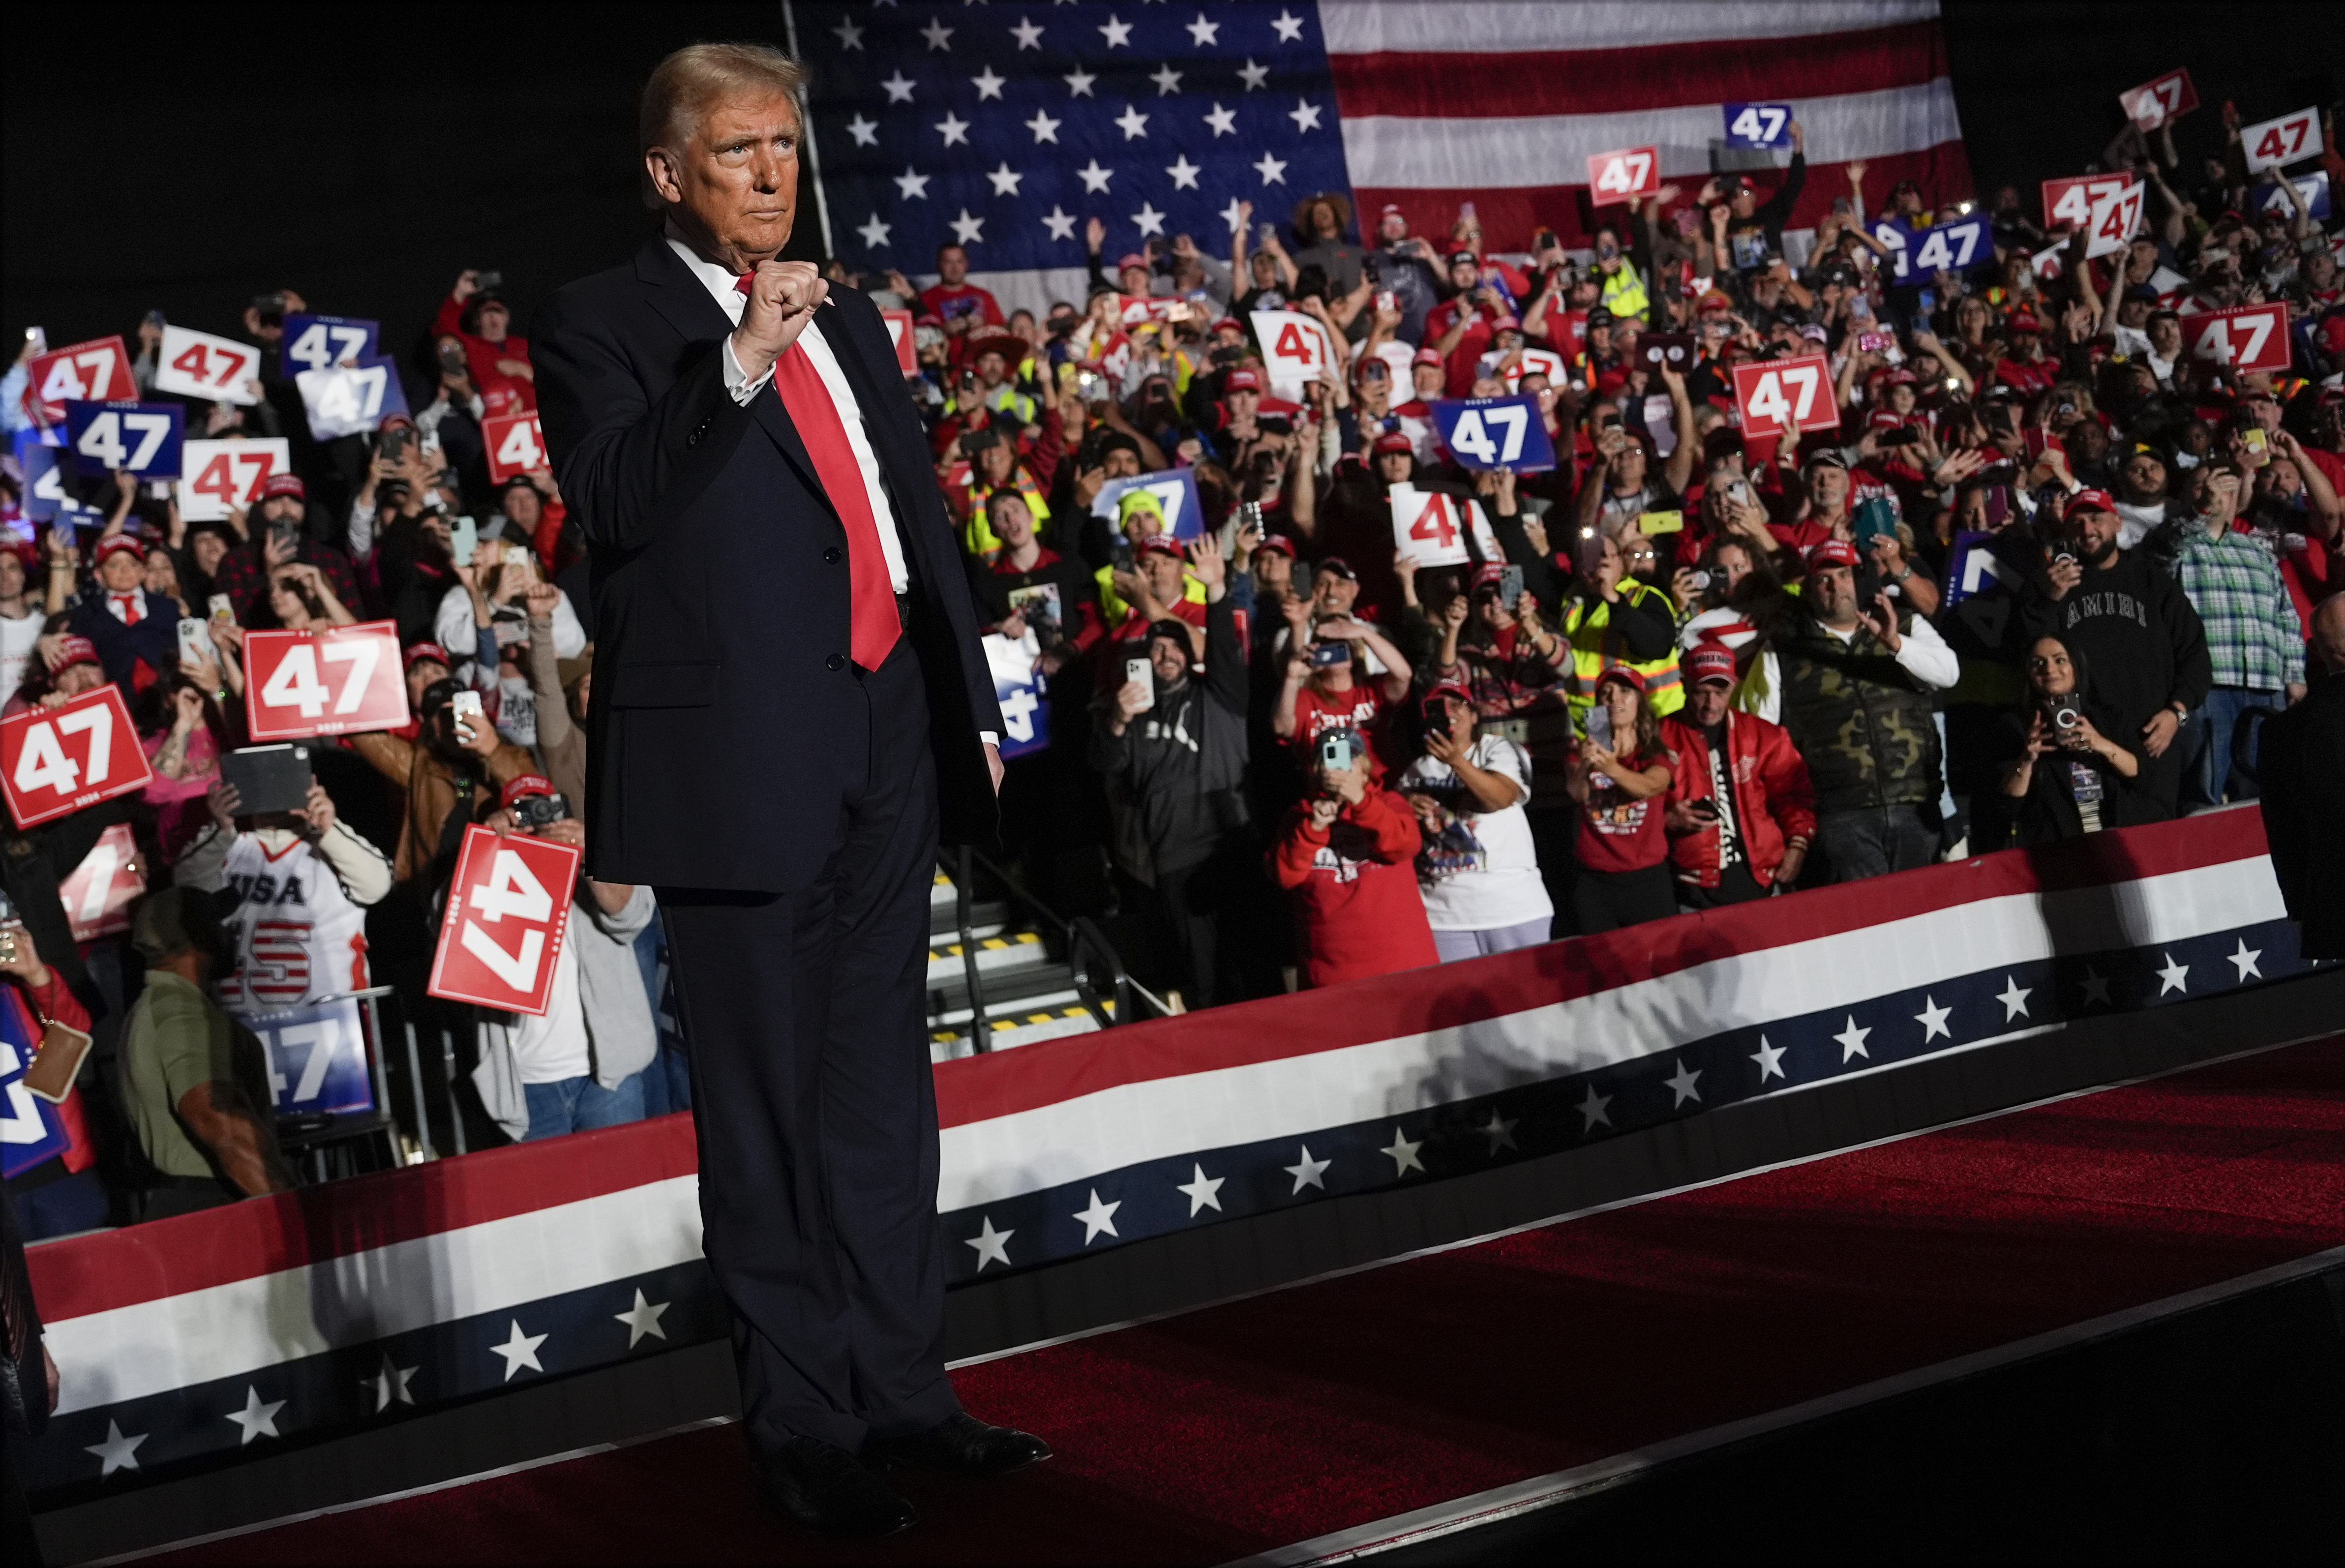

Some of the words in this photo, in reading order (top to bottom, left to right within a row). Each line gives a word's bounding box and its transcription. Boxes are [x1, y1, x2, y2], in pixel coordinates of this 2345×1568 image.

[1731, 107, 1786, 142] 47
[2137, 75, 2182, 124] 47
[2256, 119, 2310, 159] 47
[1597, 152, 1652, 194] 47
[2099, 193, 2139, 239] 47
[1916, 221, 1981, 271] 47
[289, 323, 368, 370] 47
[1275, 323, 1326, 364] 47
[2193, 312, 2275, 366] 47
[40, 346, 116, 401] 47
[172, 344, 247, 386] 47
[319, 366, 387, 422] 47
[1747, 365, 1820, 424] 47
[77, 411, 171, 470] 47
[496, 419, 550, 469] 4
[1451, 404, 1528, 464] 47
[193, 452, 273, 502] 47
[2067, 591, 2147, 629] AMIRI
[261, 639, 380, 718] 47
[999, 689, 1039, 743] 4
[13, 702, 113, 796] 47
[75, 791, 100, 807] 2024
[61, 843, 119, 922] 7
[227, 873, 306, 906] USA
[461, 849, 553, 993] 47
